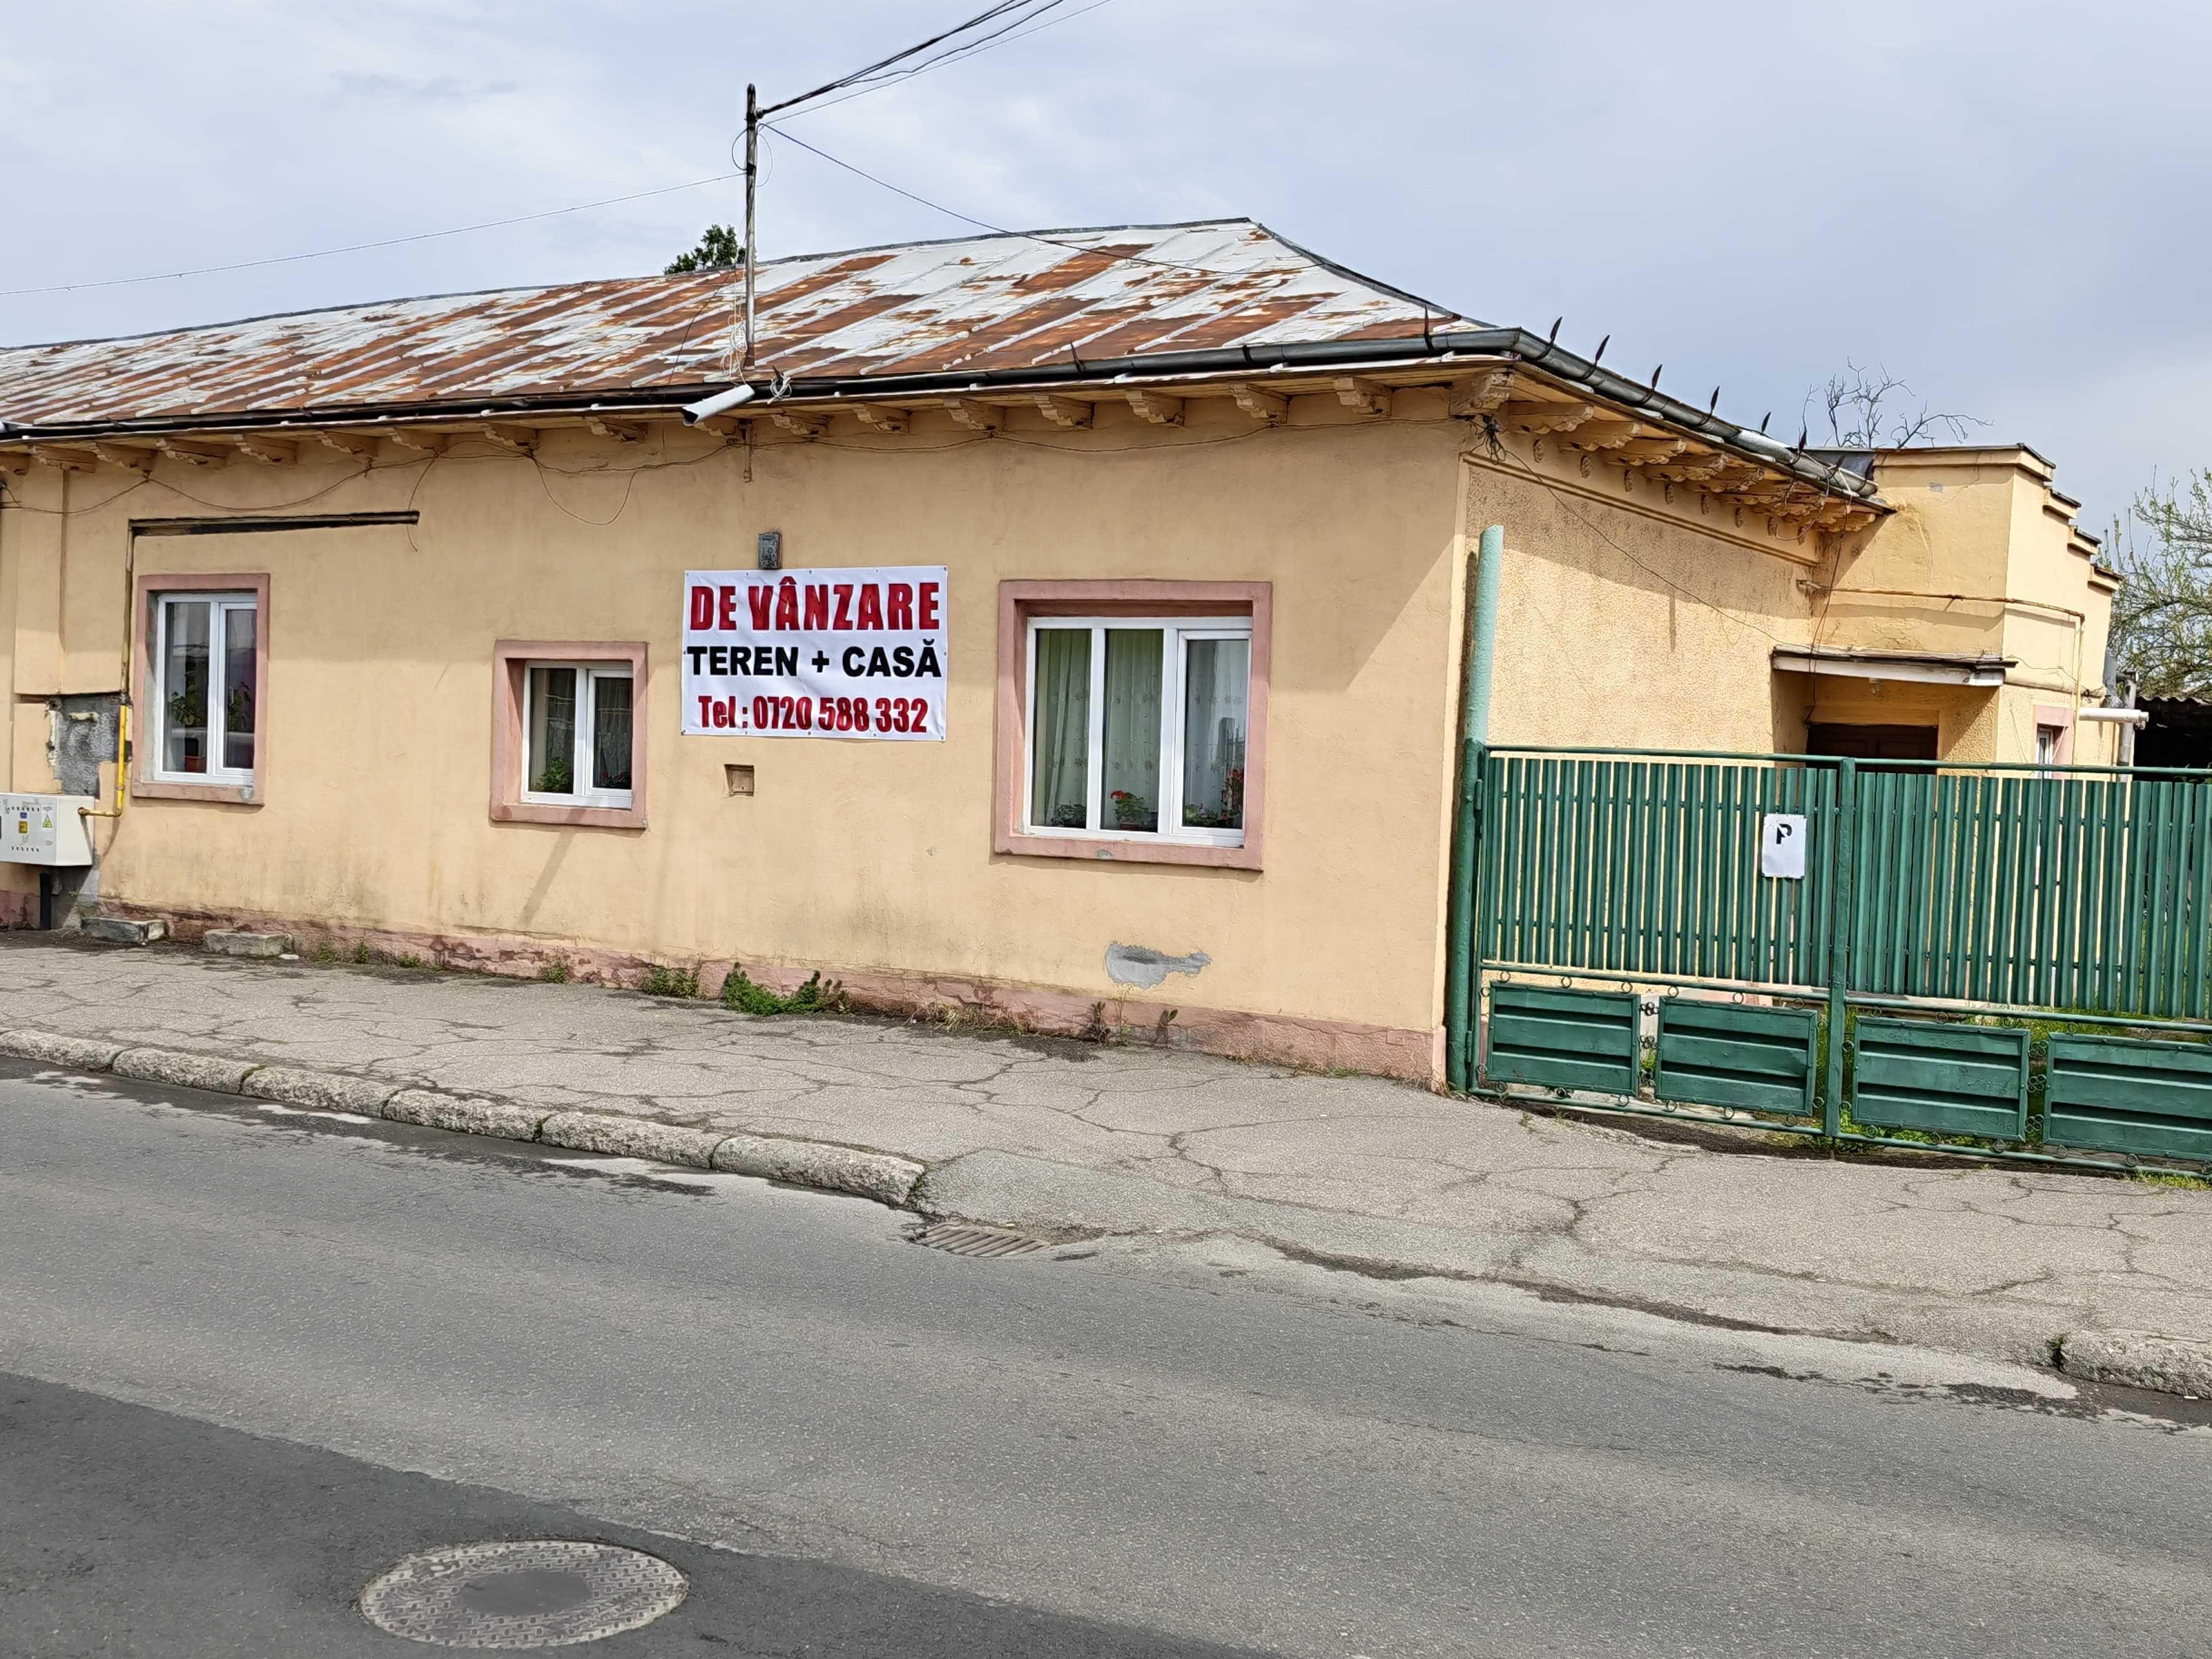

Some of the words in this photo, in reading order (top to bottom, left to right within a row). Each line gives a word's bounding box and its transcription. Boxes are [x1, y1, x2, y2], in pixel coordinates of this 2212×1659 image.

[690, 585, 737, 631] DE
[748, 576, 940, 631] VÂNZARE
[686, 646, 799, 677] TEREN
[842, 638, 942, 678] CASĂ
[753, 696, 812, 730] 0720
[818, 697, 869, 732] 588
[875, 698, 928, 733] 332
[1776, 823, 1793, 845] P
